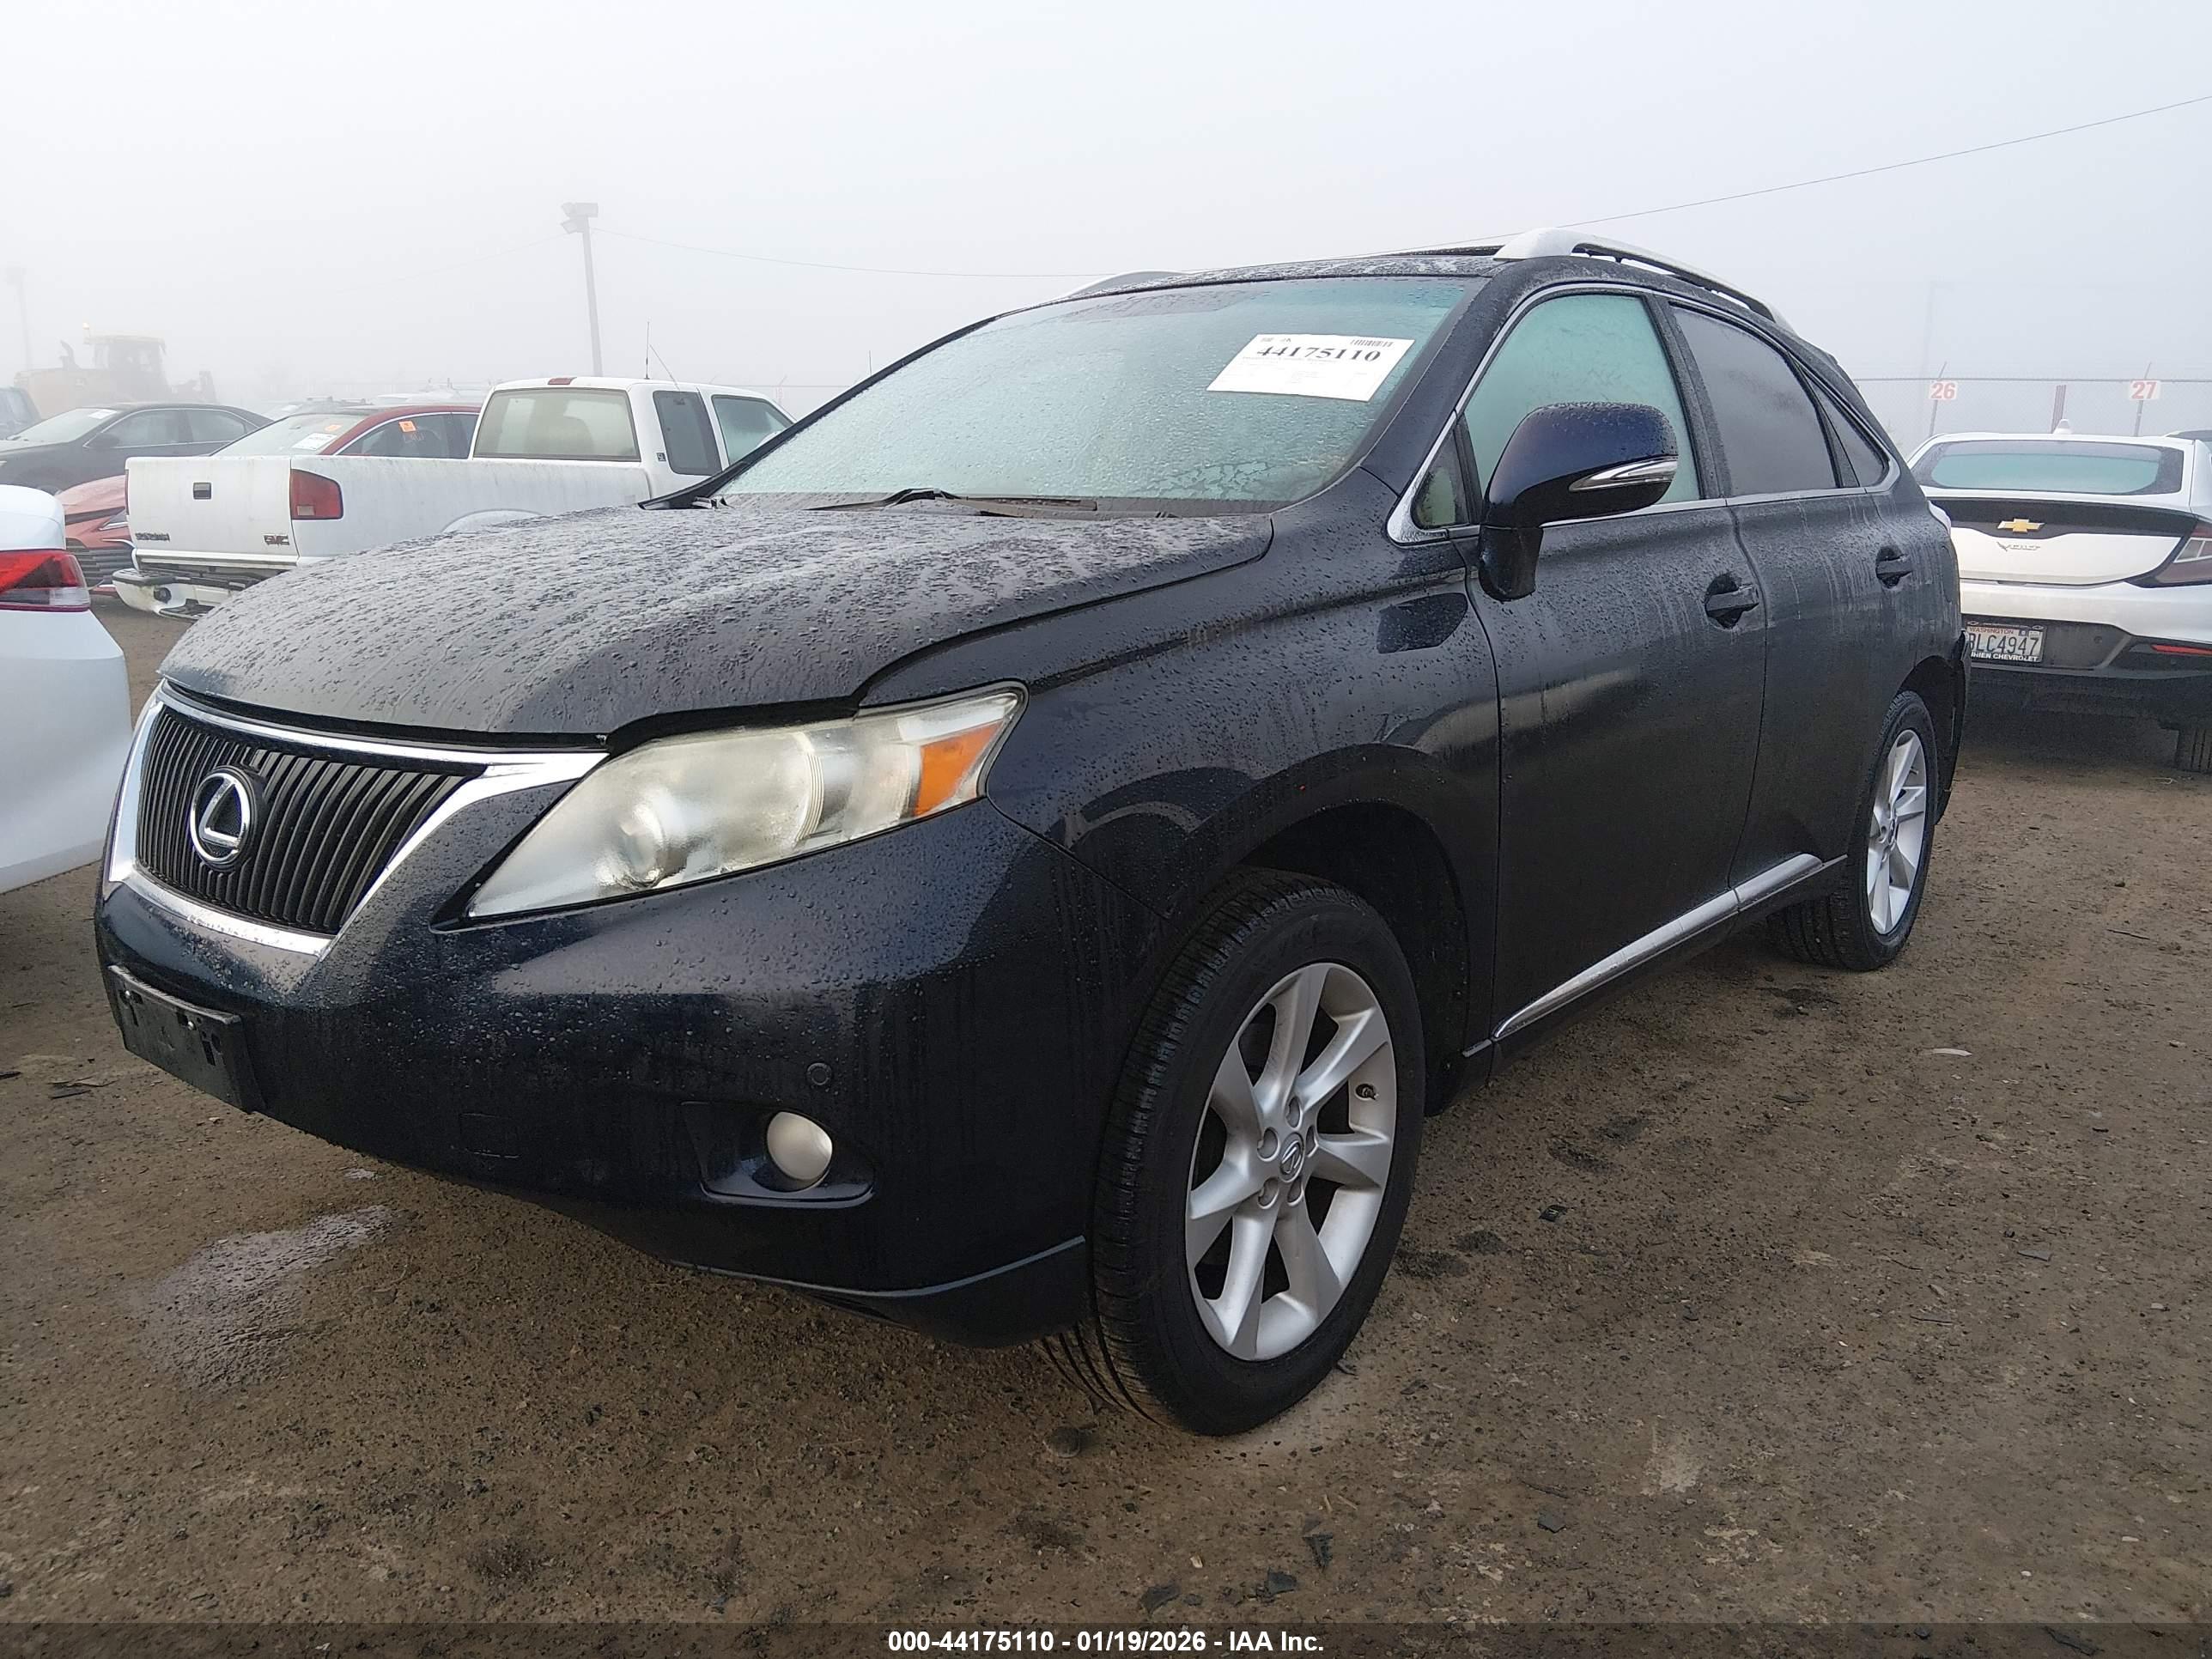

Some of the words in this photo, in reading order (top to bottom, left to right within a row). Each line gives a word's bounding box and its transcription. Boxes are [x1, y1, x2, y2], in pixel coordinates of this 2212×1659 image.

[1257, 345, 1381, 362] 44175110
[1930, 382, 1956, 399] 26
[2130, 381, 2158, 400] 27
[1993, 653, 2038, 662] CHEVROLET
